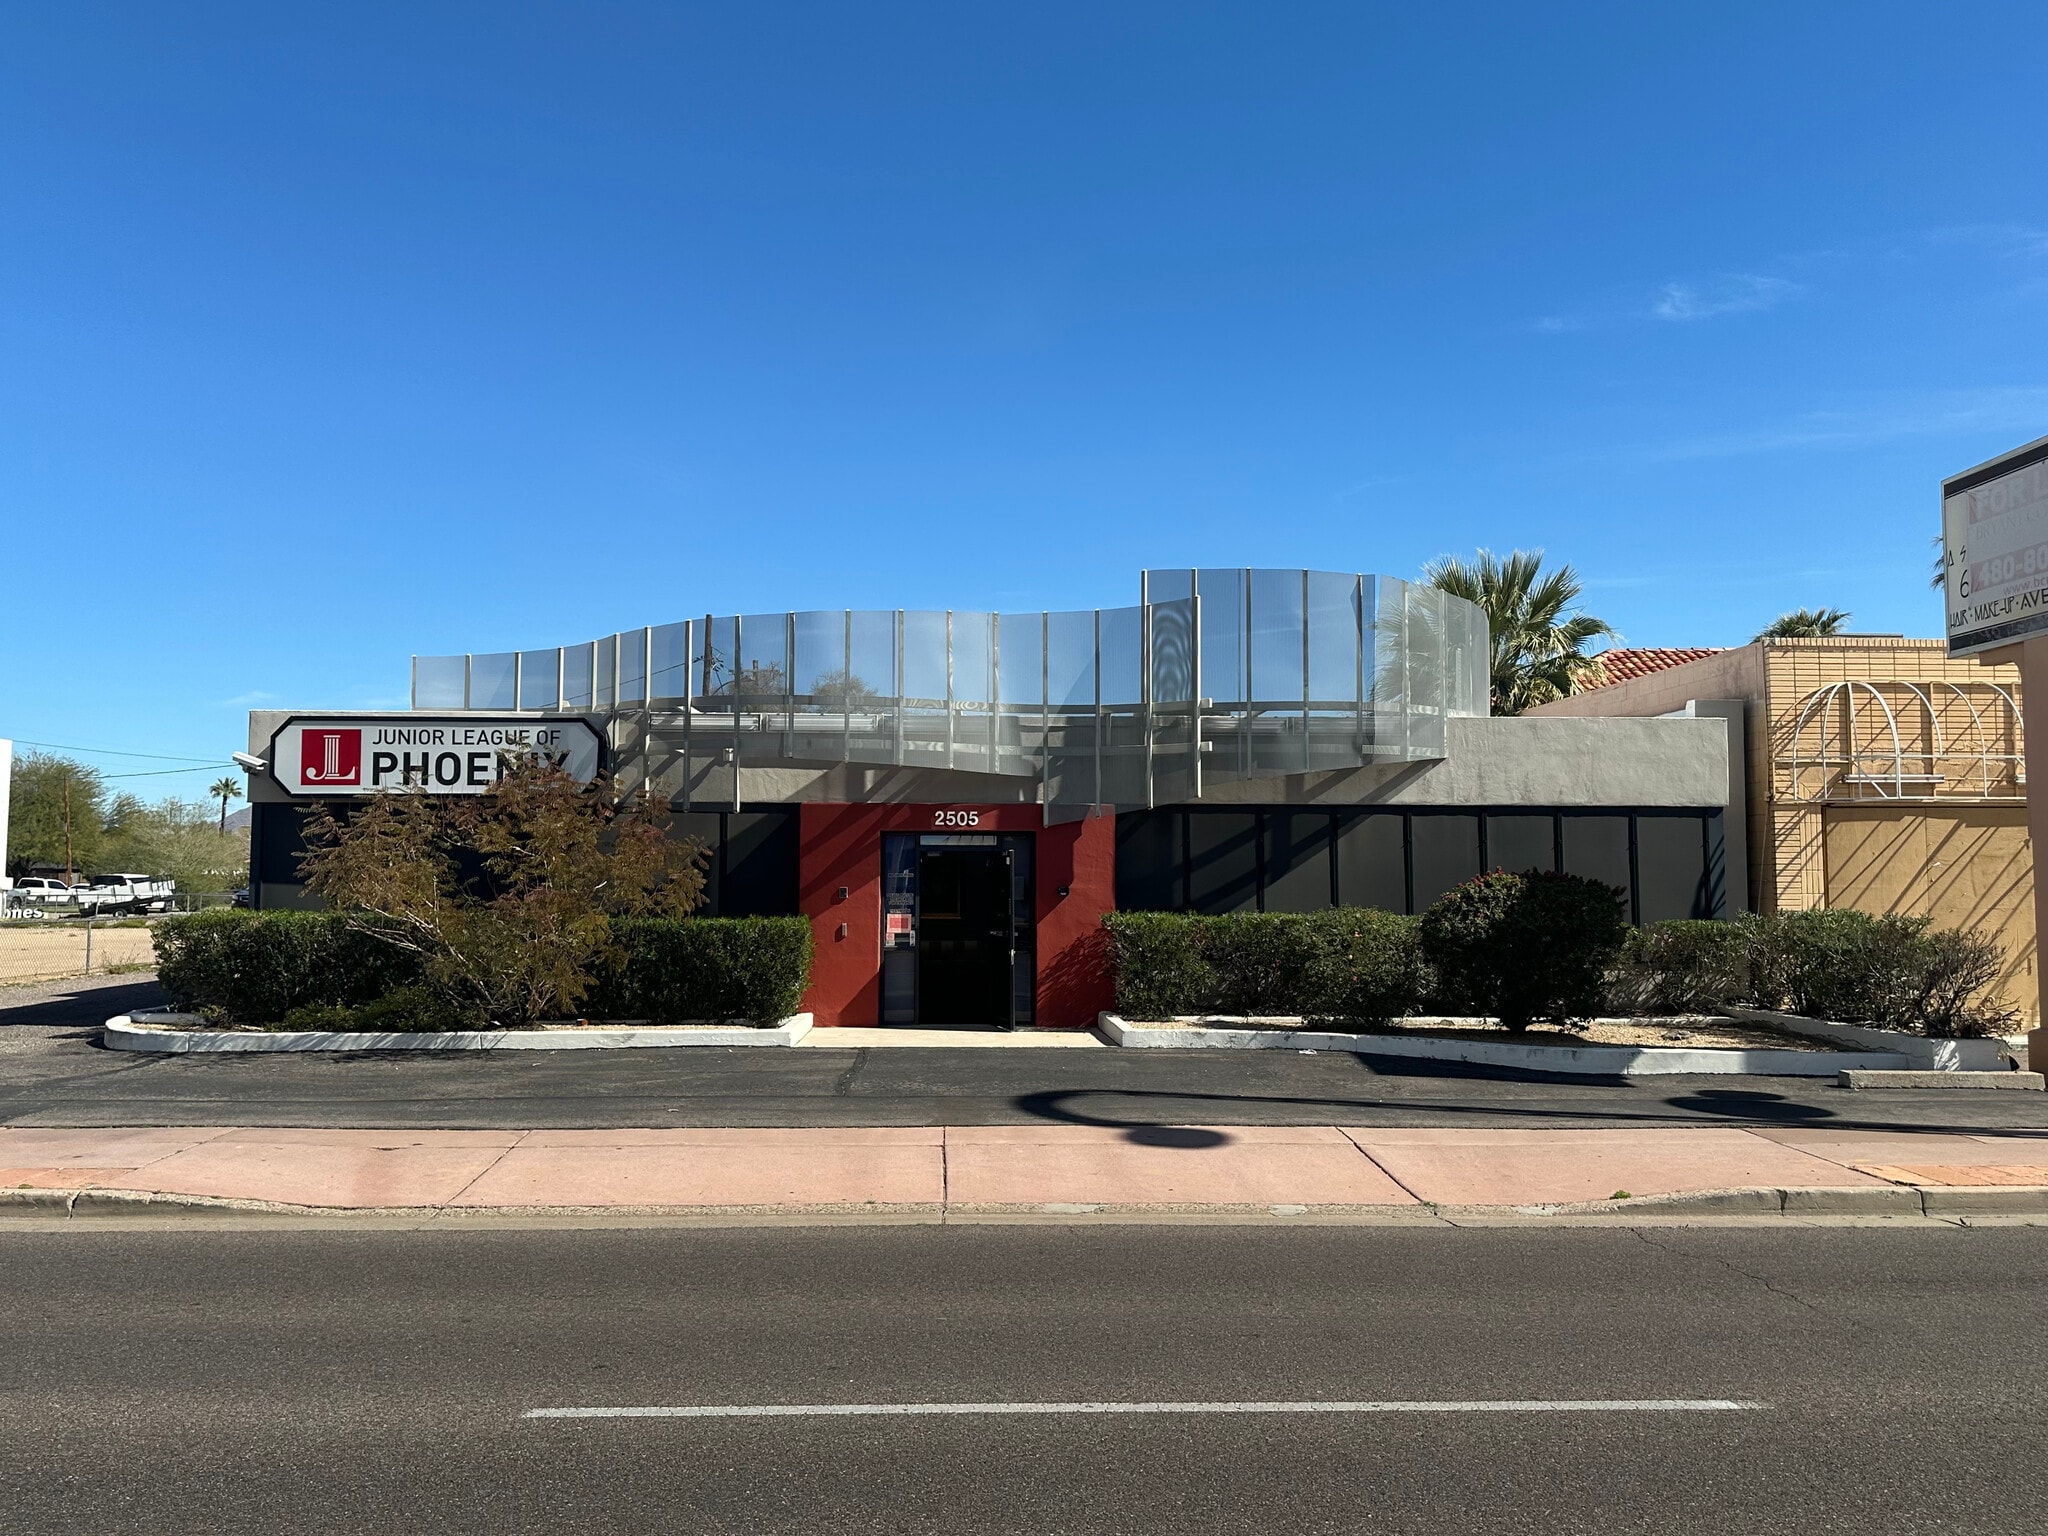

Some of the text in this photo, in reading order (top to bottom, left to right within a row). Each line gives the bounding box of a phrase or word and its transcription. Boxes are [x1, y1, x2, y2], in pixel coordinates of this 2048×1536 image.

[2002, 577, 2048, 596] www.bc
[1974, 596, 2015, 622] MAKE-UP
[372, 729, 561, 745] JUNIOR LEAGUE OF
[934, 811, 979, 826] 2505
